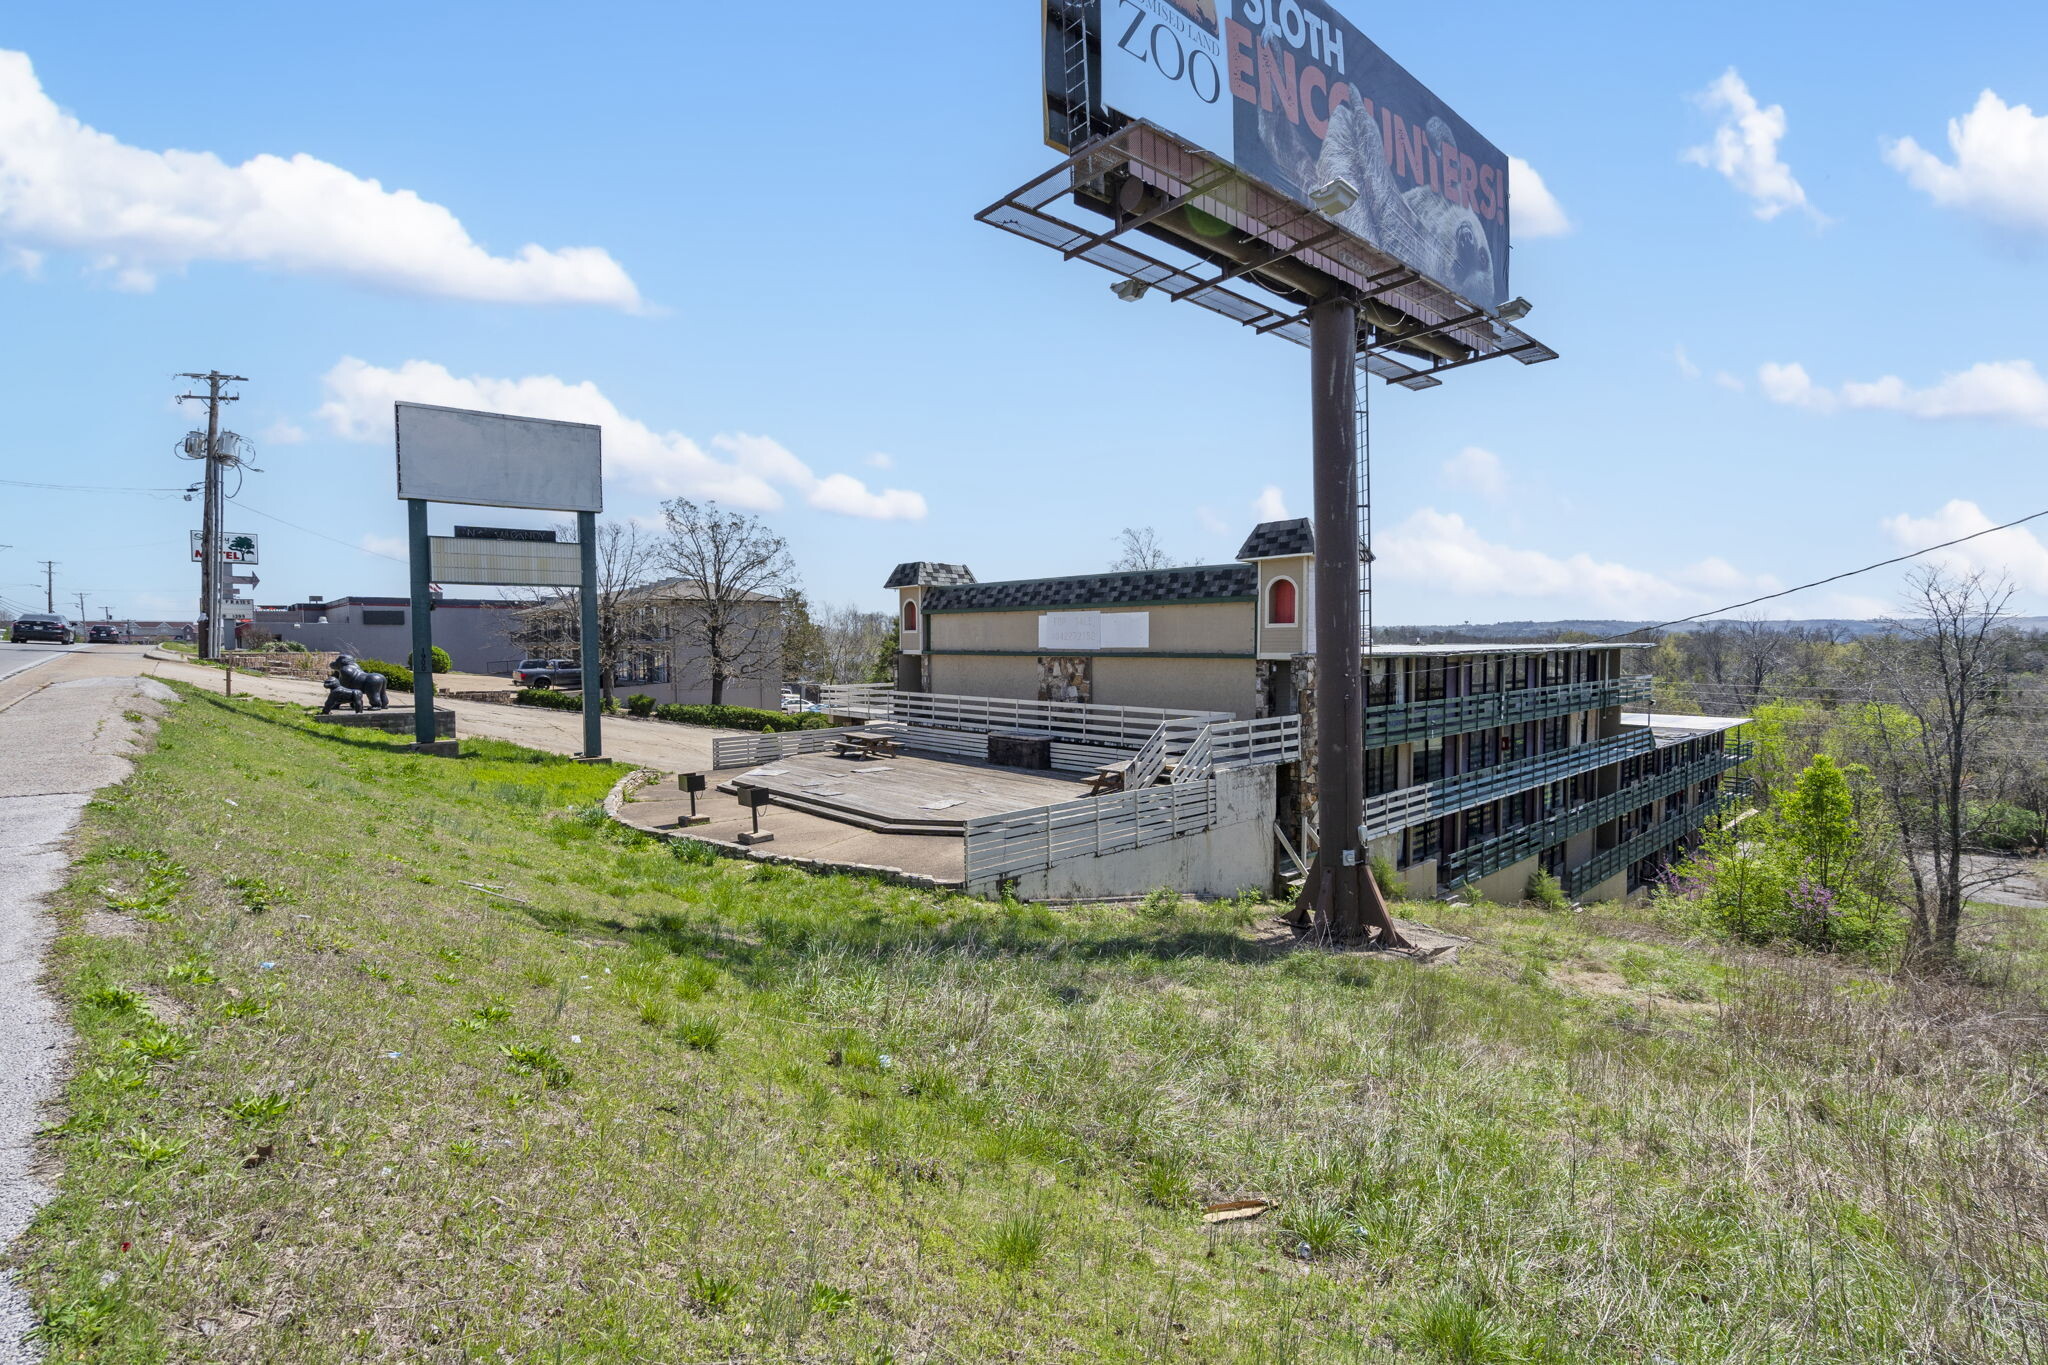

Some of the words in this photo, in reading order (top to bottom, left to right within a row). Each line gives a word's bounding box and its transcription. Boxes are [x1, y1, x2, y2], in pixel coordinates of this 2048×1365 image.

[1118, 0, 1221, 104] ZOO
[1187, 25, 1220, 56] LAND
[1242, 0, 1345, 75] SLOTH
